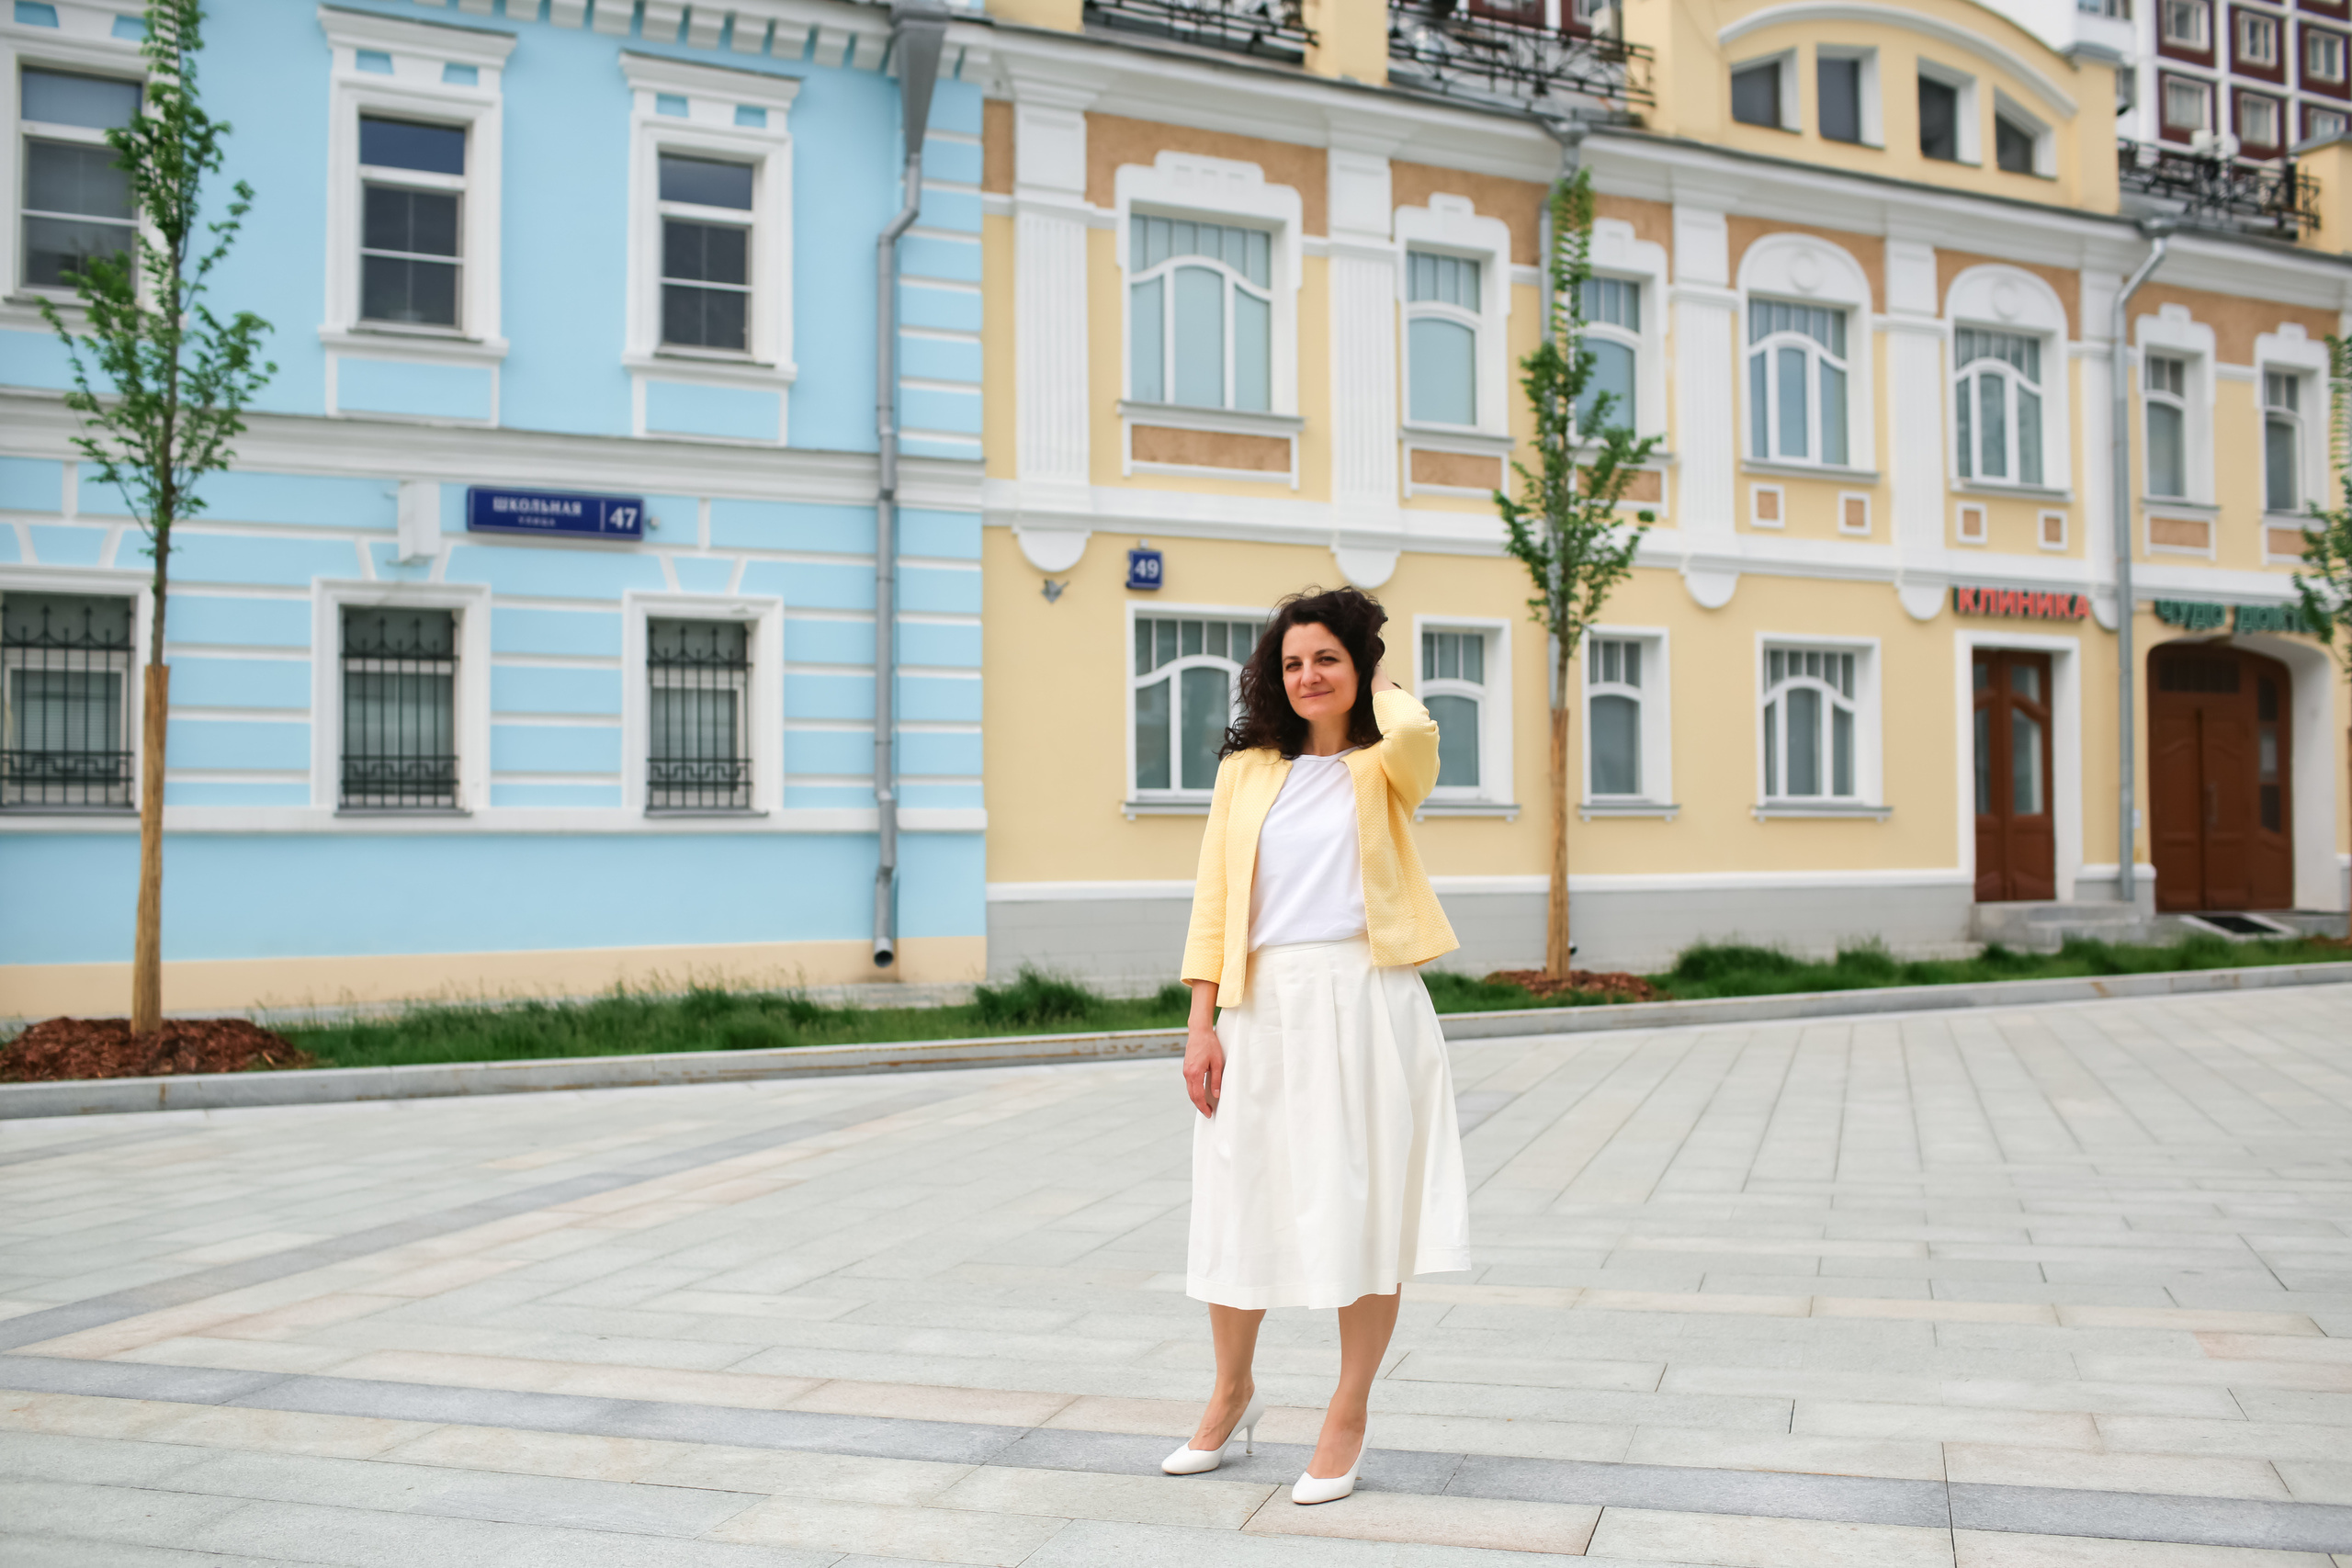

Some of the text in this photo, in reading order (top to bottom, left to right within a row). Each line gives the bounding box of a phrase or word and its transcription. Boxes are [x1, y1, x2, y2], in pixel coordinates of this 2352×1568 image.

[492, 496, 639, 529] ШКОЛЬНАЯ 47
[1134, 558, 1159, 580] 49
[1956, 586, 2091, 619] КЛИНИКА
